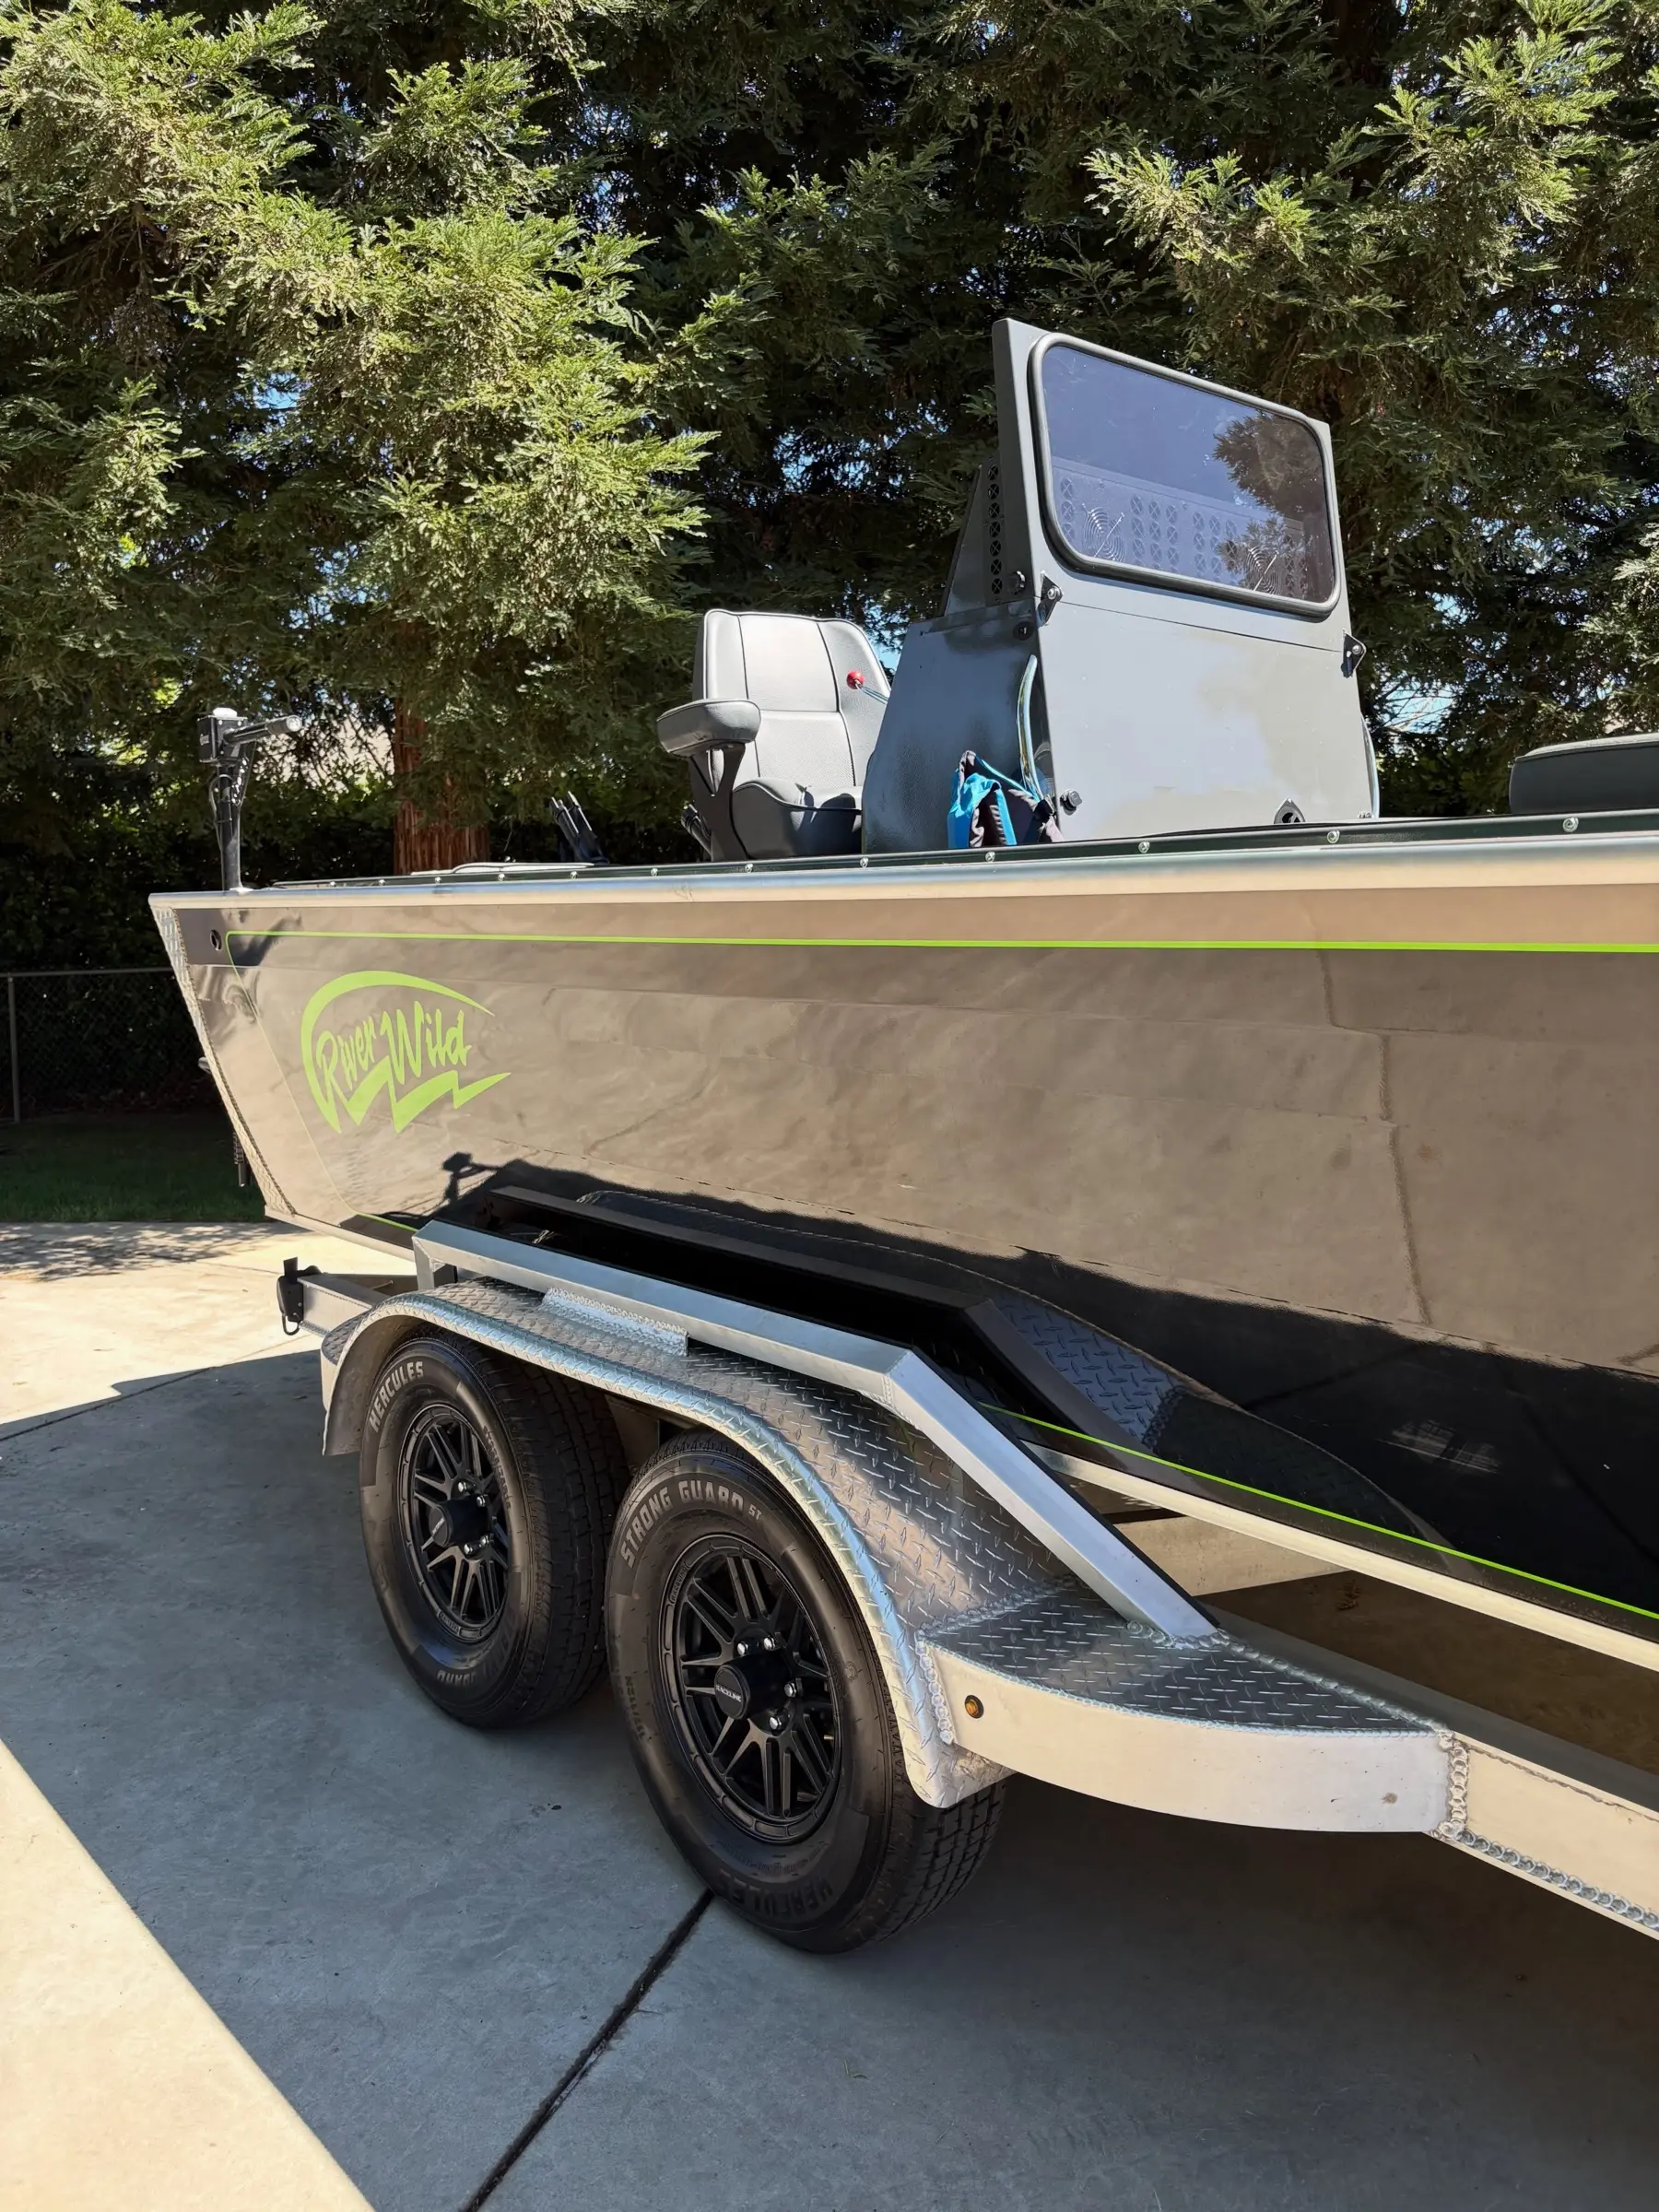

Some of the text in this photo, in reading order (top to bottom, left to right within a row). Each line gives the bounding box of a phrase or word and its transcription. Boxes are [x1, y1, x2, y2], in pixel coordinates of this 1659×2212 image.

[316, 1001, 472, 1097] River Wild
[369, 1360, 424, 1433] HERCULES
[620, 1480, 763, 1568] STRONG GUARD ST
[715, 1684, 742, 1702] RACELINE
